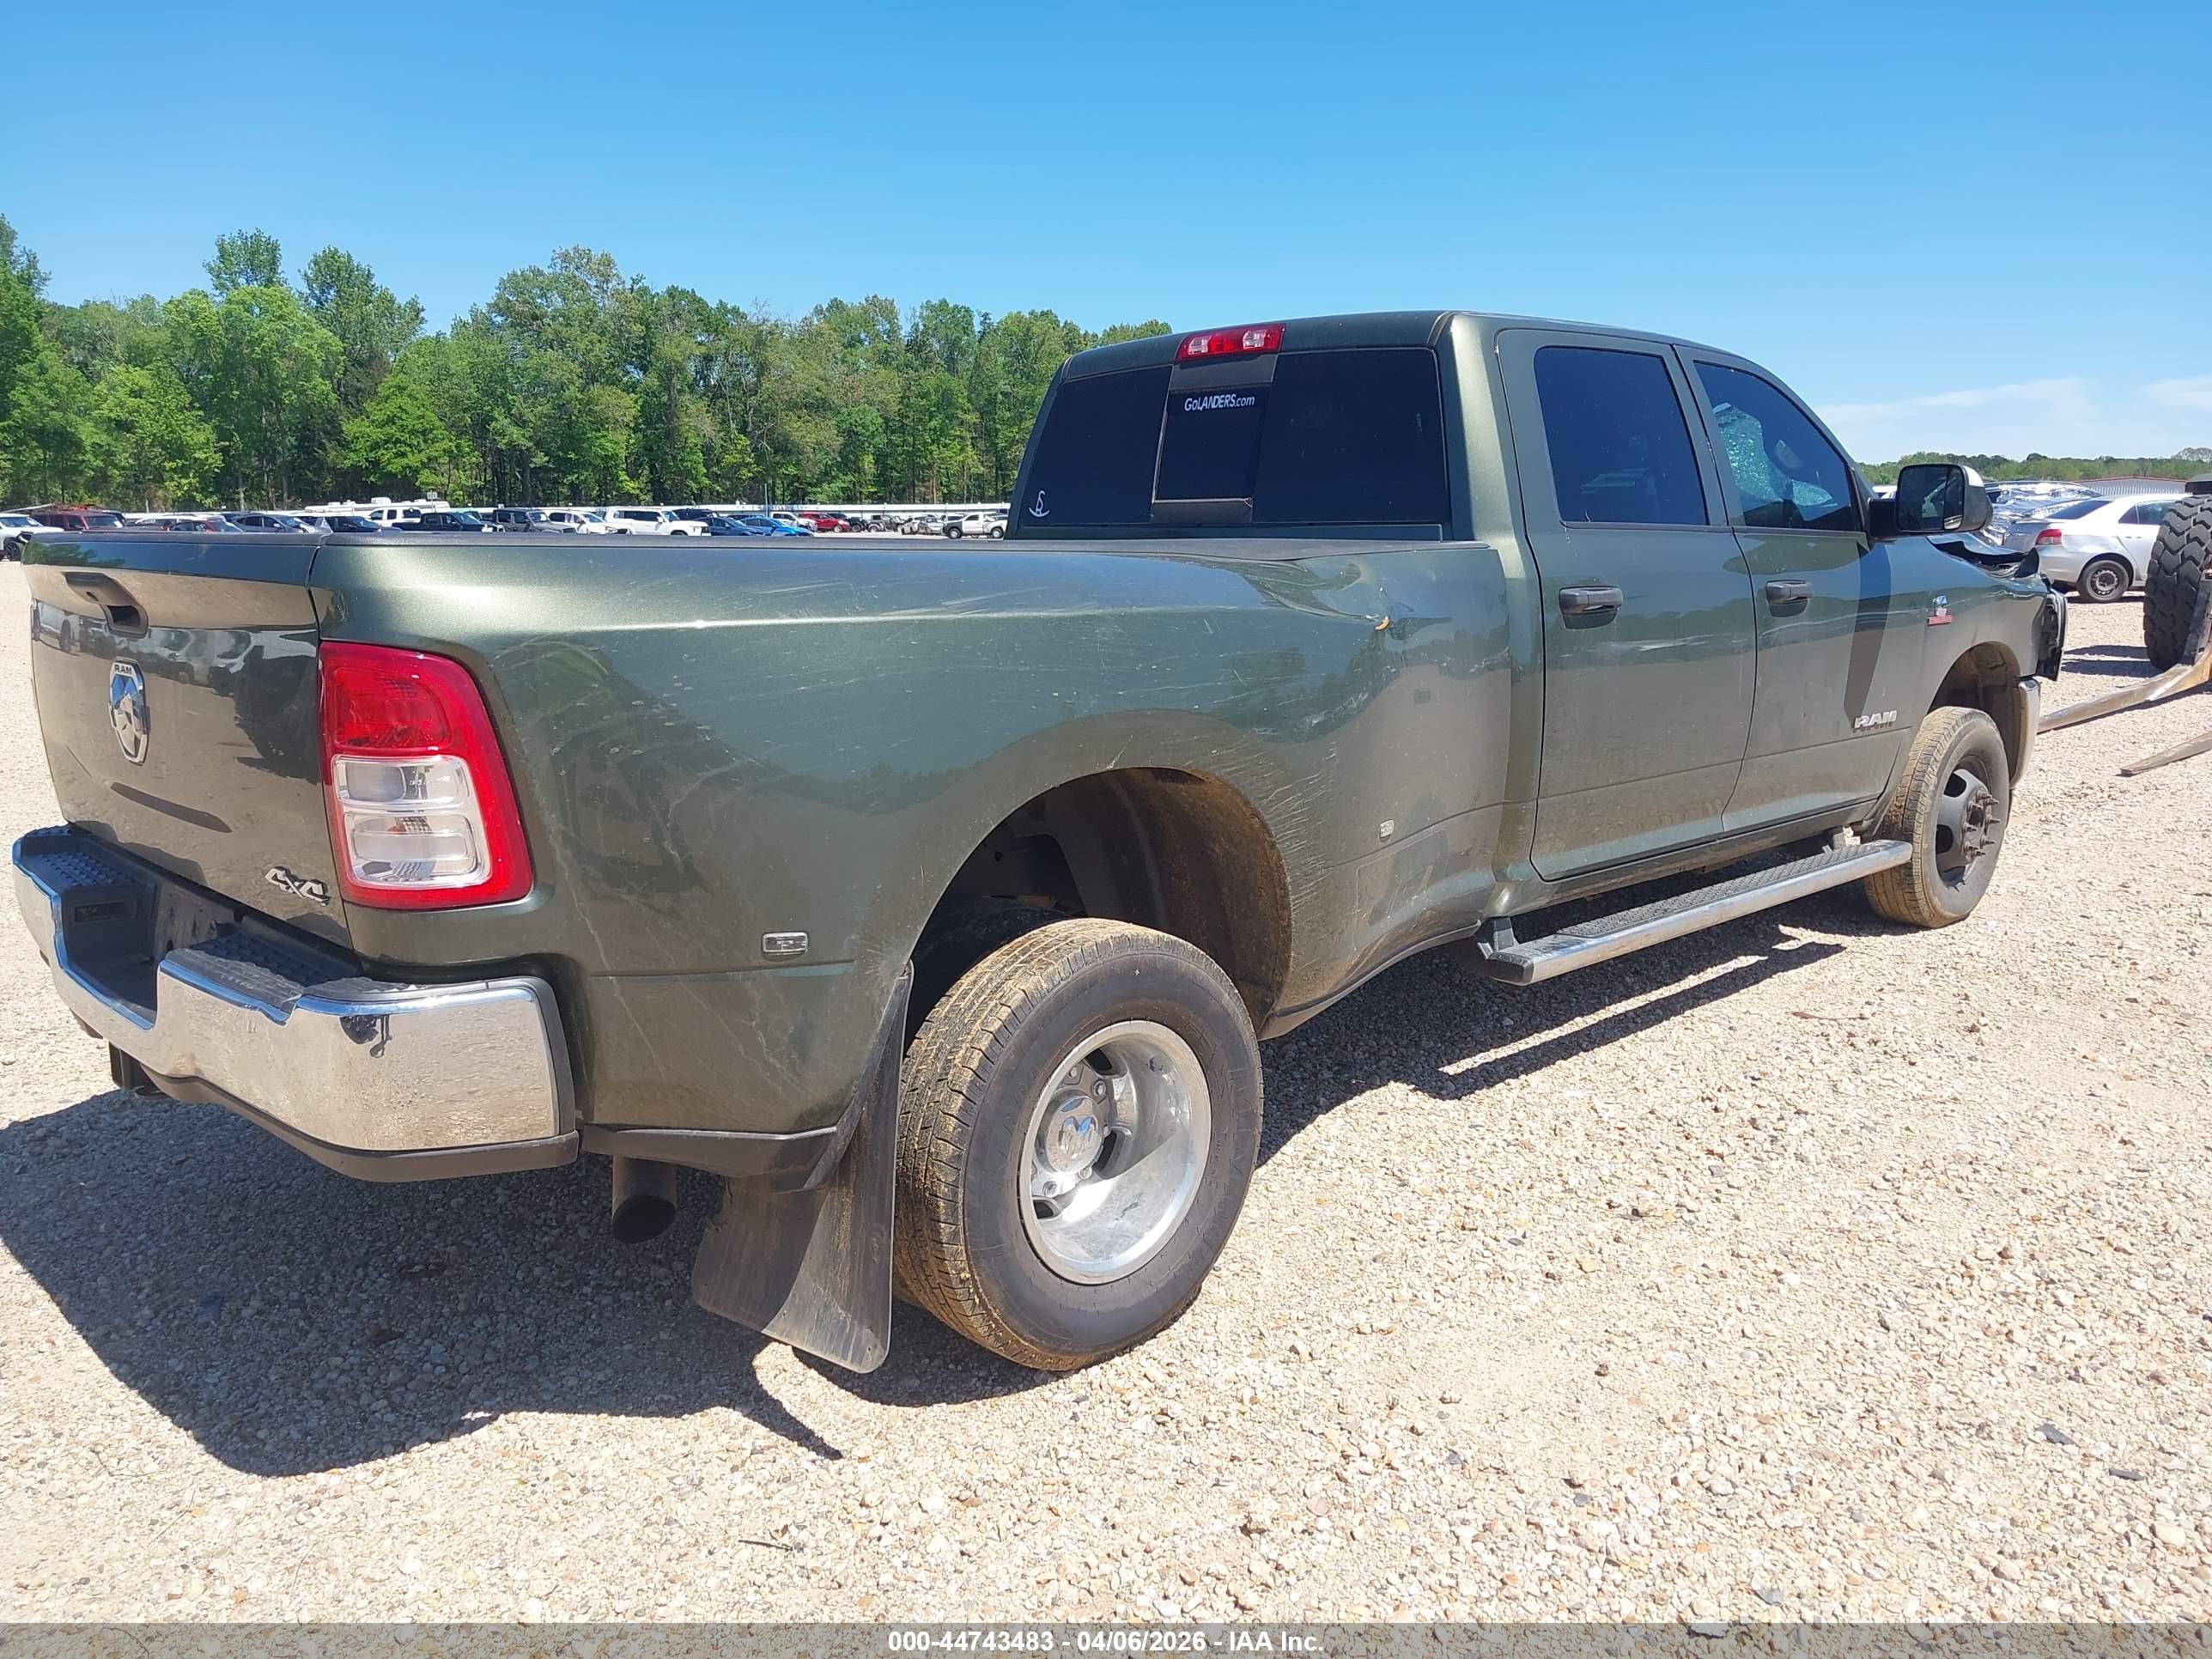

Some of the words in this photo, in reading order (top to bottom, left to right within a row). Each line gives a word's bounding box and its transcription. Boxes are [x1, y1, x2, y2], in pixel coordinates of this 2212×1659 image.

[1184, 393, 1255, 411] GoLANDERS.com
[114, 664, 132, 675] RAM
[1854, 709, 1898, 729] RAM
